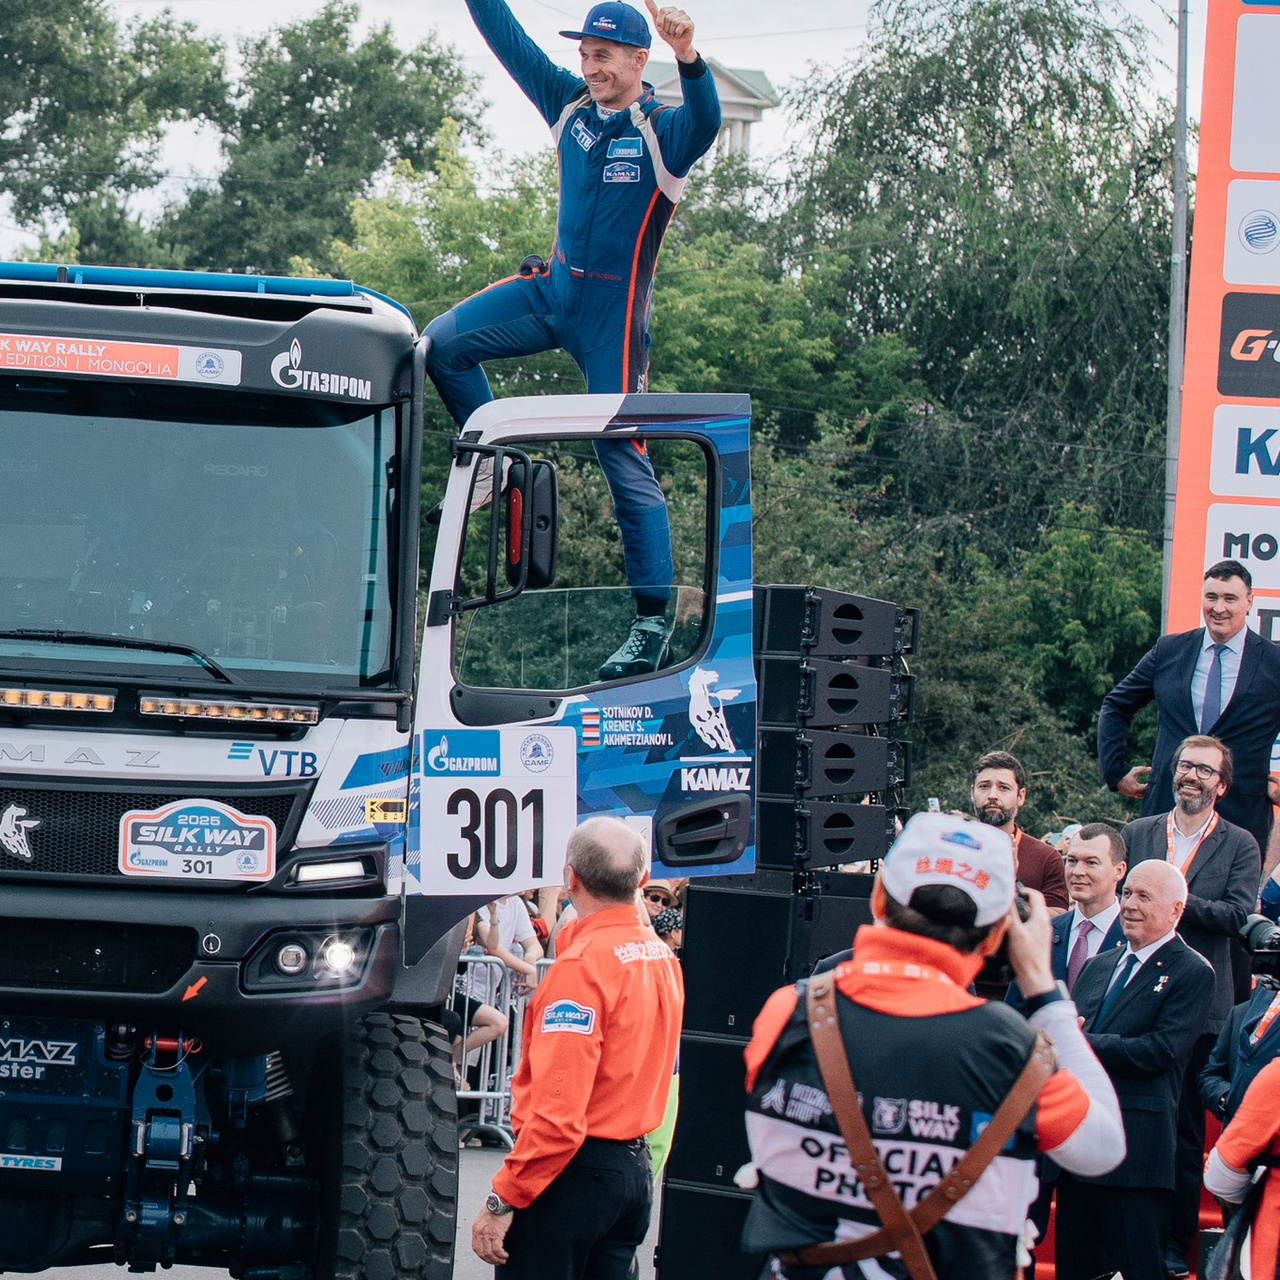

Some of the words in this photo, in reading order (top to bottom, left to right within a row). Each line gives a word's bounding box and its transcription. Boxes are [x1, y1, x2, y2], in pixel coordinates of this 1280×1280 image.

[606, 170, 636, 178] KAMAZ
[14, 339, 53, 353] WAY
[56, 342, 106, 357] RALLY
[6, 353, 68, 369] EDITION
[87, 358, 173, 375] MONGOLIA
[302, 371, 372, 401] ГАЗПРОМ
[602, 706, 643, 719] SOTNIKOV
[644, 707, 654, 719] D.
[602, 720, 636, 732] KRENEV
[637, 721, 645, 732] S.
[602, 733, 667, 746] AKHMETZIANOV
[257, 748, 318, 778] VTB
[449, 757, 497, 771] GAZPROM
[680, 768, 752, 792] KAMAZ
[177, 814, 220, 826] 2025
[136, 825, 201, 843] SILK
[204, 828, 259, 846] WAY
[446, 787, 544, 880] 301
[173, 844, 223, 853] RALLY
[182, 859, 213, 874] 301
[565, 1011, 589, 1020] WAY
[908, 1099, 961, 1124] SILK
[908, 1119, 961, 1142] WAY
[800, 1136, 961, 1179] OFCIA
